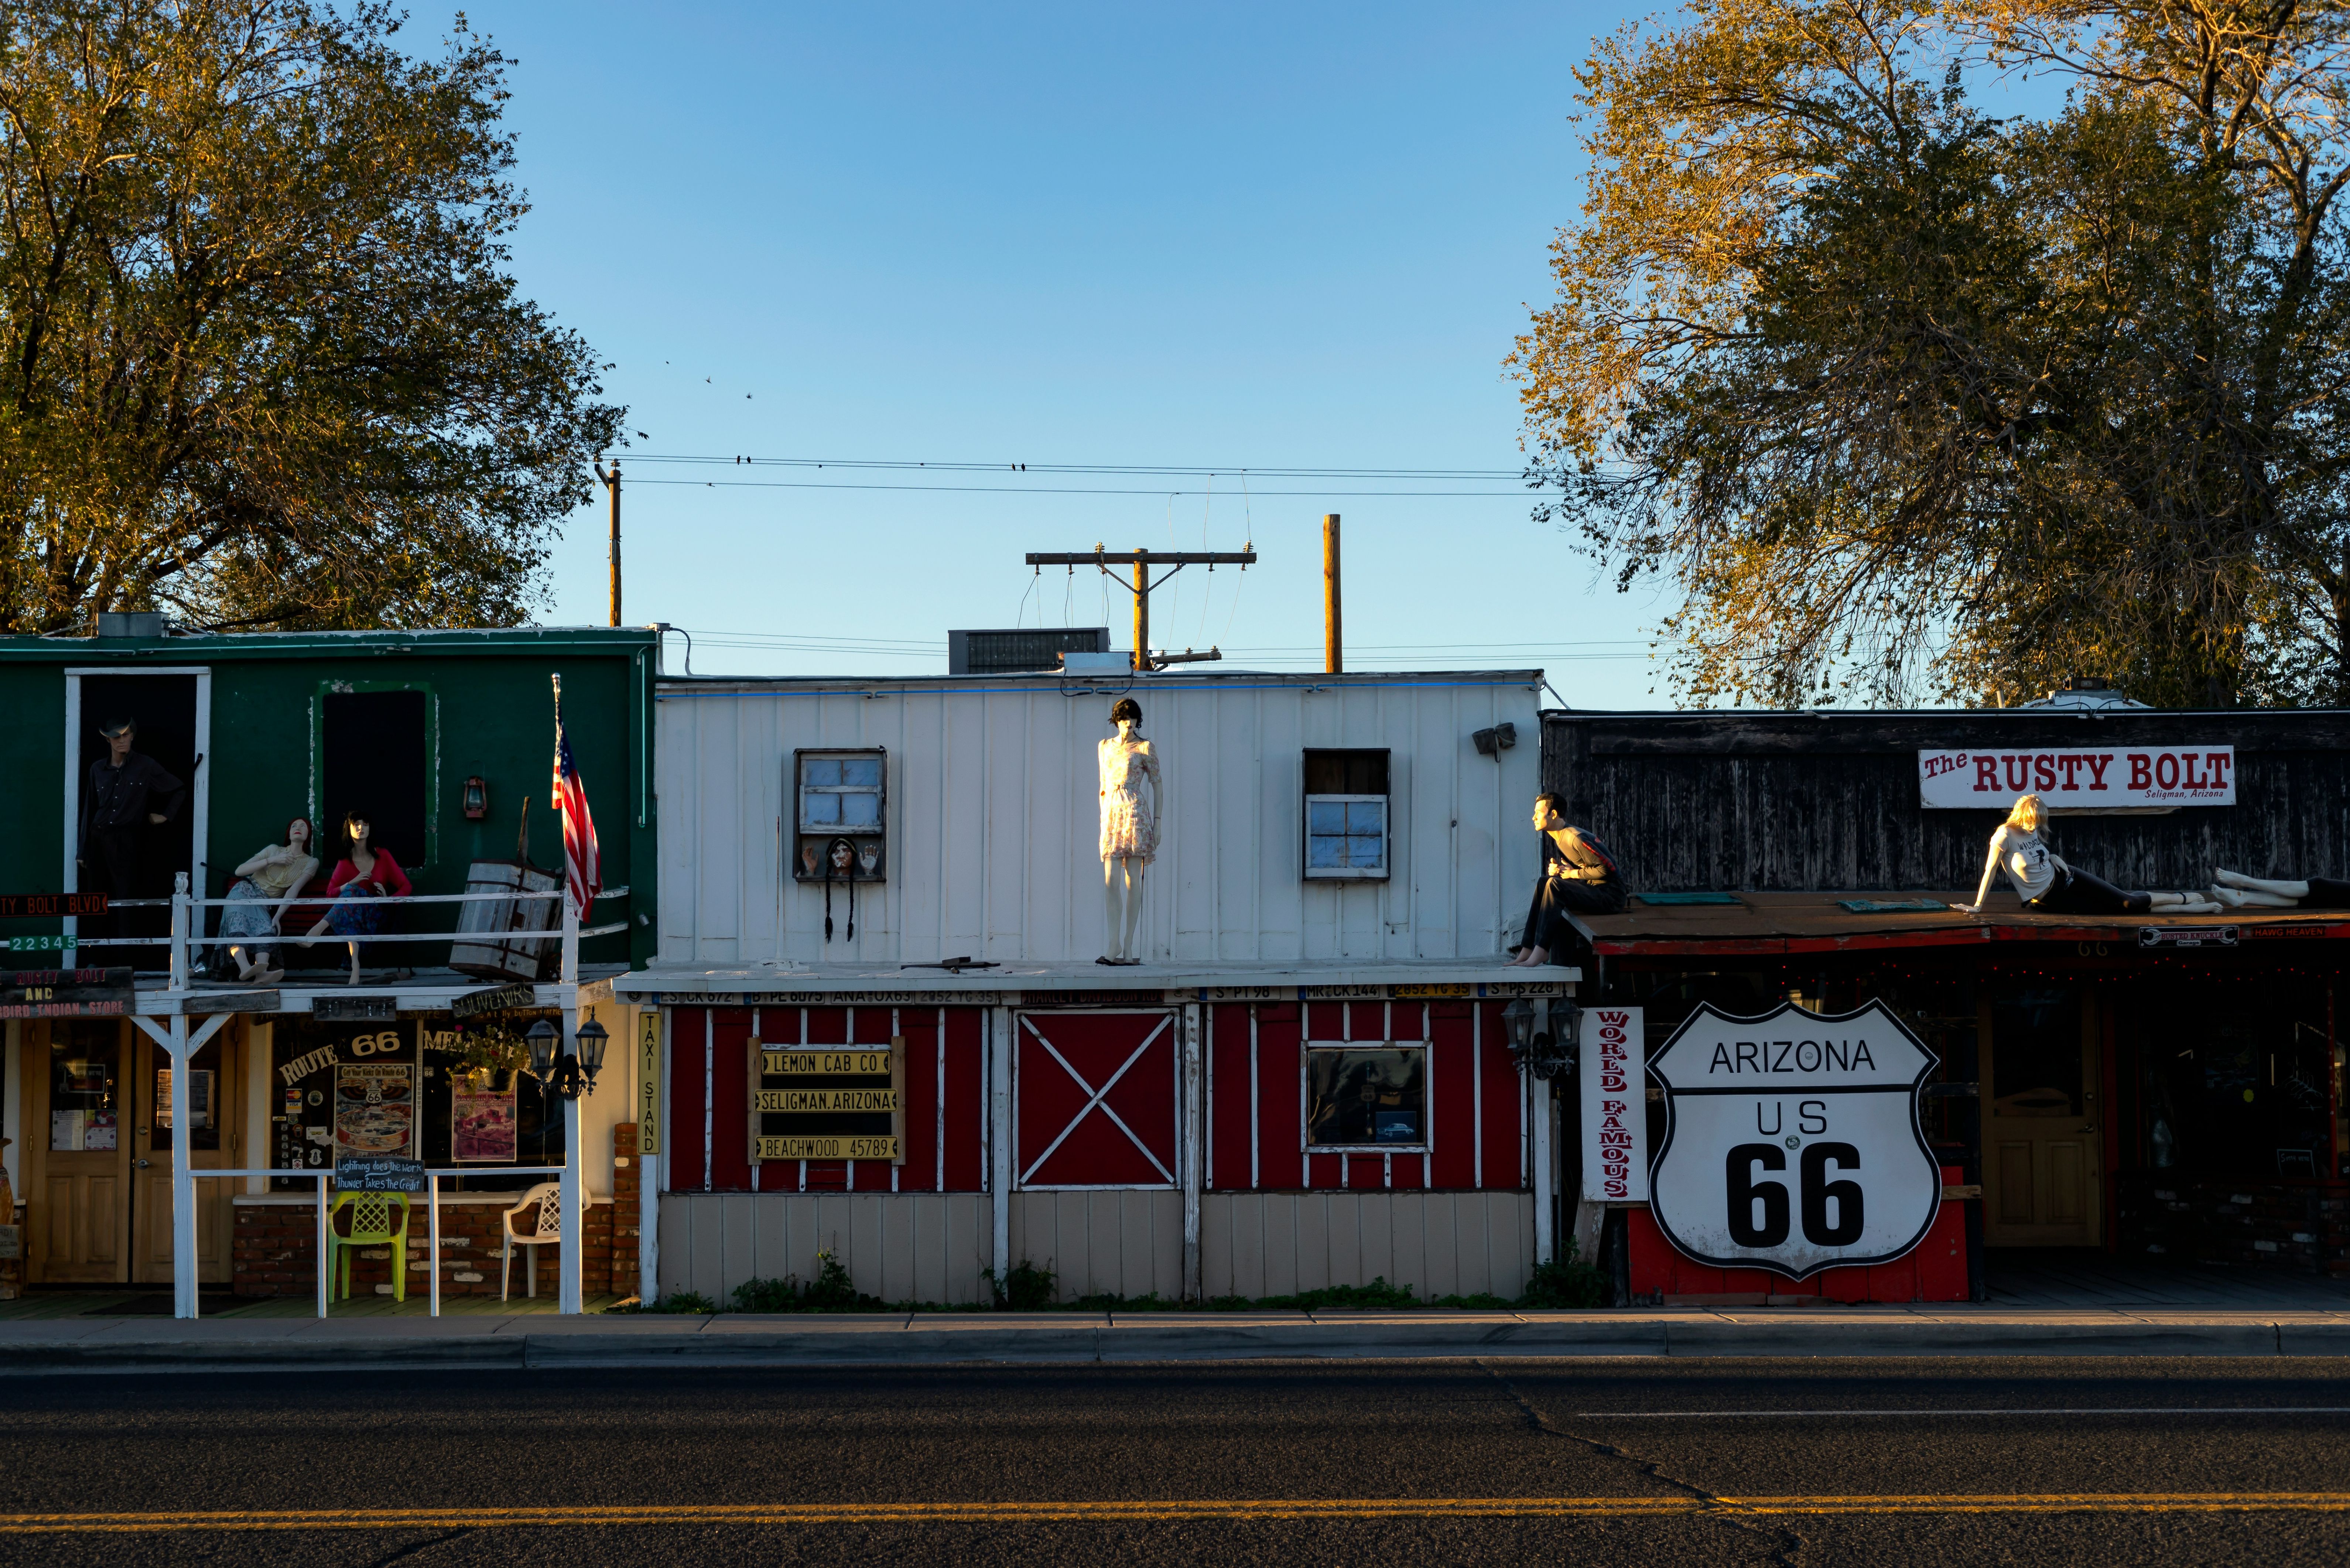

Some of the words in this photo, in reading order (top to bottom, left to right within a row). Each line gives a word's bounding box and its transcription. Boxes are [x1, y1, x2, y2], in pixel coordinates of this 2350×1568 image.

[1925, 753, 1968, 778] The
[1972, 754, 2114, 792] RUSTY
[2127, 753, 2231, 791] BOLT
[2145, 790, 2188, 799] Seligman,
[2190, 788, 2224, 798] Arizona
[27, 896, 58, 914] BOLT
[69, 896, 100, 913] BLVD
[2255, 928, 2285, 937] HAWG
[2287, 927, 2324, 936] HEAVEN
[13, 936, 76, 950] 22345
[16, 971, 58, 985] RUSTY
[75, 969, 106, 983] BOLT
[25, 987, 53, 1001] AND
[1217, 986, 1224, 998] S
[1234, 986, 1249, 997] PT
[1253, 985, 1269, 997] 98
[1307, 985, 1324, 997] MR
[1333, 985, 1350, 996] CK
[1353, 985, 1376, 996] 144
[1396, 984, 1427, 995] 2852
[1433, 984, 1448, 994] YG
[1454, 983, 1468, 994] 35
[1491, 983, 1499, 994] S
[1529, 982, 1553, 993] 228
[454, 985, 534, 1017] SOUVENIRS
[660, 992, 677, 1002] ES
[686, 992, 704, 1002] CK
[708, 992, 732, 1002] 672
[770, 992, 786, 1002] PE
[833, 992, 865, 1002] ANA
[921, 991, 952, 1002] 2852
[37, 1002, 80, 1016] INDIAN
[89, 1001, 124, 1015] STORE
[352, 1031, 400, 1057] 66
[644, 1016, 654, 1071] TAXI
[1596, 1011, 1630, 1092] WORLD
[1709, 1040, 1876, 1074] ARIZONA
[279, 1044, 338, 1086] ROUTE
[774, 1055, 816, 1072] LEMON
[824, 1055, 851, 1071] CAB
[860, 1054, 877, 1071] CO
[762, 1092, 831, 1110] SELIGMAN,
[833, 1092, 890, 1109] ARIZONA
[644, 1082, 654, 1151] STAND
[766, 1139, 839, 1157] BEACHWOOD
[850, 1139, 887, 1156] 45789
[1599, 1100, 1632, 1198] FAMOUS
[373, 1160, 387, 1171] does
[2281, 1153, 2296, 1163] Sorry
[1726, 1142, 1864, 1248] 66
